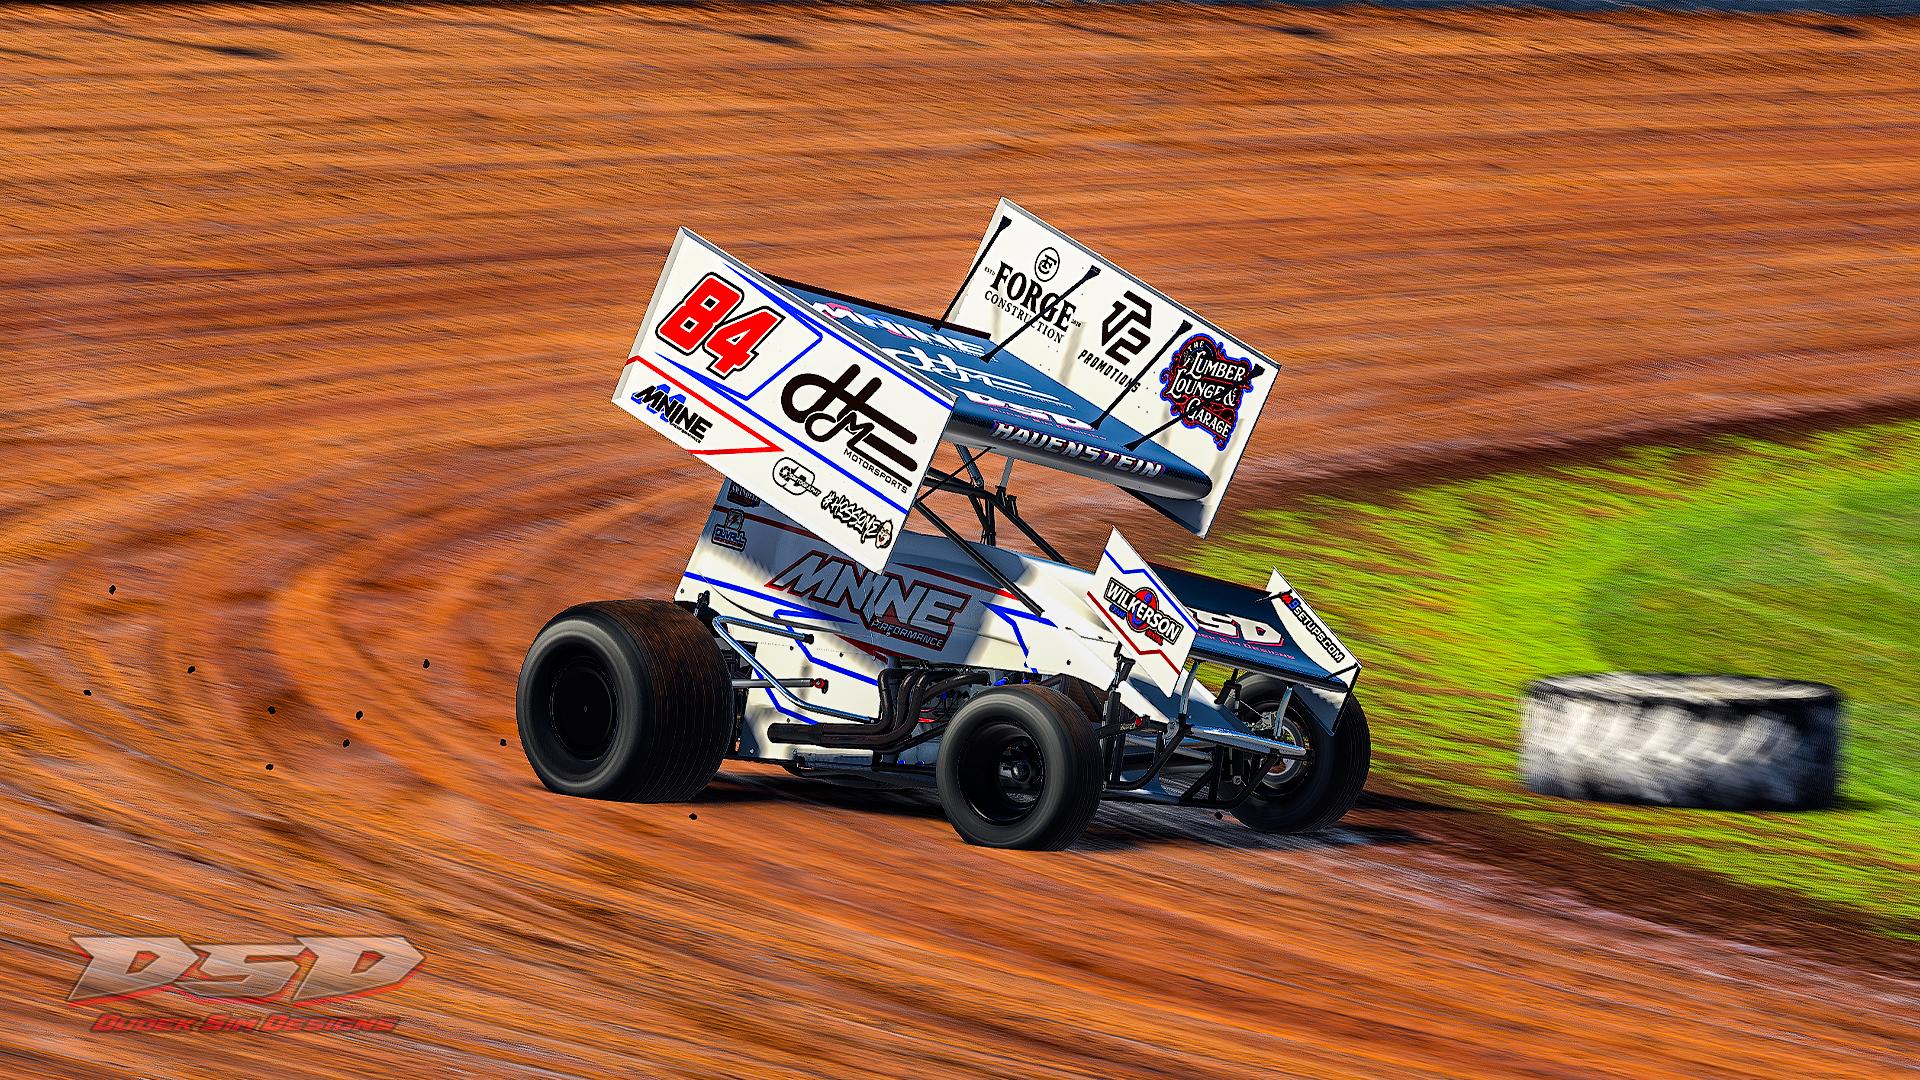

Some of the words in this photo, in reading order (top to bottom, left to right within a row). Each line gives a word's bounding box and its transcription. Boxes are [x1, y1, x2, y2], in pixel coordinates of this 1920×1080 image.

[990, 261, 1077, 333] FORGE
[657, 272, 785, 379] 84
[1188, 340, 1205, 352] THE
[1184, 350, 1246, 381] LUMBER
[633, 385, 713, 440] MNINE
[1186, 398, 1232, 437] GARAGE
[843, 447, 908, 494] MOTORSPORTS
[991, 422, 1163, 478] HAUENSTEIN
[1106, 582, 1180, 640] WILKERSON
